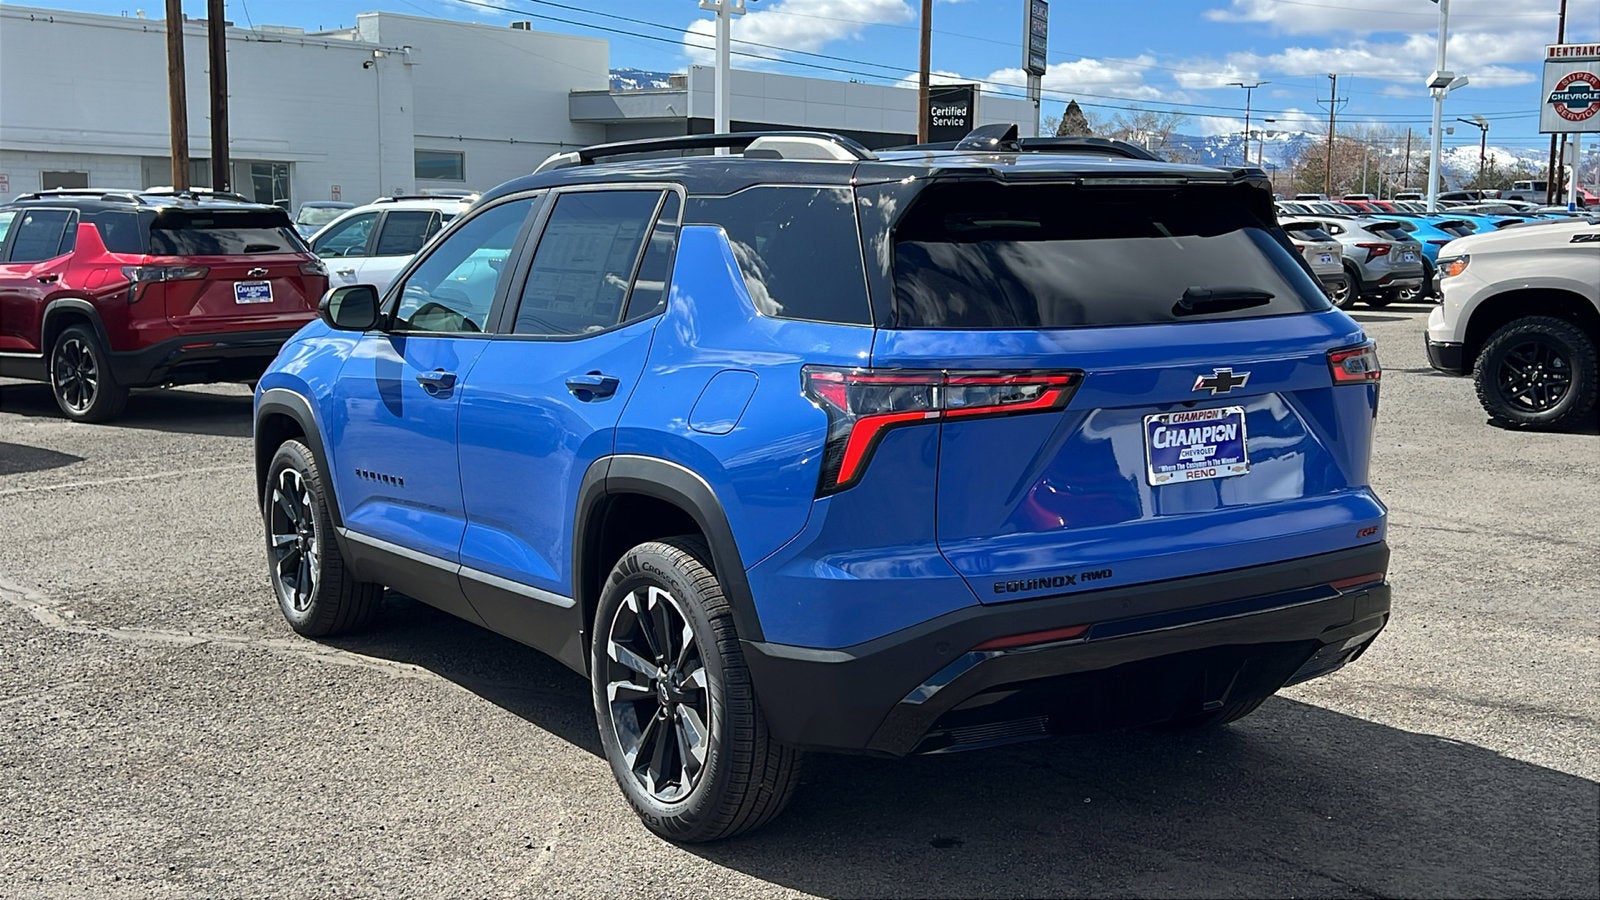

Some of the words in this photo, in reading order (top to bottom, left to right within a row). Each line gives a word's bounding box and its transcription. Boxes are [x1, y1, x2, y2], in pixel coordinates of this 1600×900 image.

[1562, 73, 1597, 86] SUPER
[931, 106, 967, 116] Certified
[1556, 104, 1599, 121] SERVICE
[932, 116, 964, 126] Service
[1172, 410, 1219, 423] CHAMPION
[1153, 423, 1237, 449] CHAMPION
[1181, 447, 1215, 457] CHEVROLET
[1186, 468, 1216, 480] RENO
[993, 574, 1077, 593] EQUINOX
[1081, 569, 1113, 582] AWD
